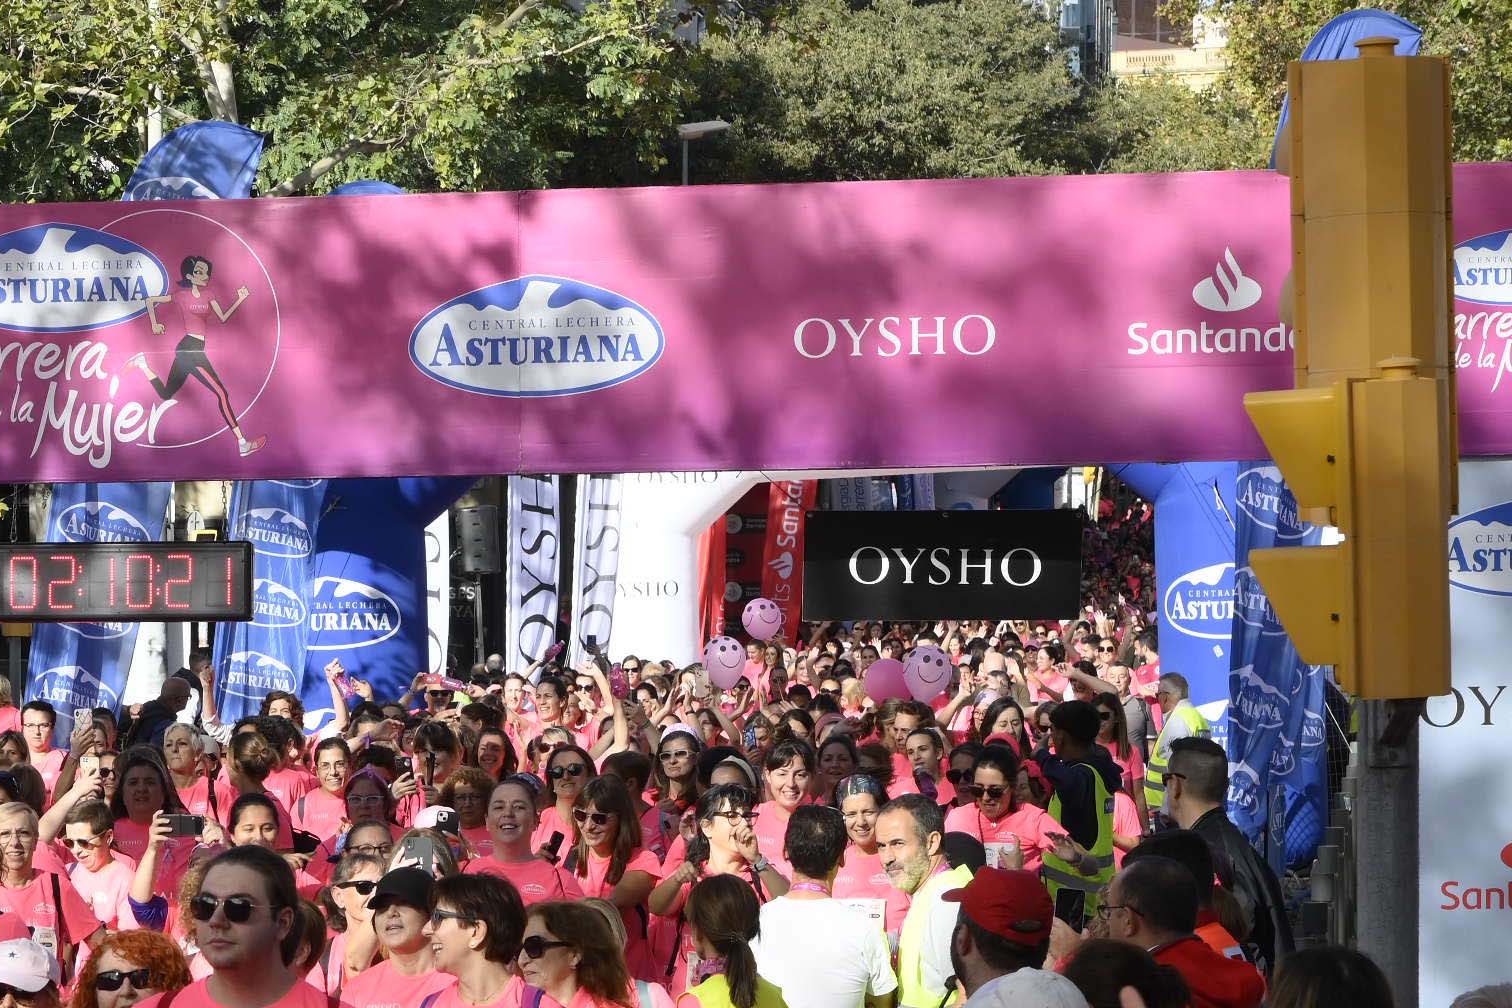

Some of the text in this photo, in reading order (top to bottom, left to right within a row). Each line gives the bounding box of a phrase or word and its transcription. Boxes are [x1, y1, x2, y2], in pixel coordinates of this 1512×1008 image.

[72, 259, 144, 272] LECHERA
[468, 316, 636, 331] CENTRAL LECHERA
[794, 314, 997, 358] OYSHO
[1127, 321, 1296, 355] Santand
[1454, 312, 1512, 340] arre
[429, 323, 644, 367] ASTURIANA
[1478, 341, 1496, 368] la
[10, 384, 34, 424] la
[29, 375, 179, 469] Mujer
[519, 474, 556, 667] OYSH
[578, 471, 620, 653] OYSH
[848, 546, 1042, 587] OYSHO
[10, 555, 233, 609] 02:10:21
[618, 580, 679, 597] YSHO
[311, 612, 392, 631] URIANA
[314, 601, 334, 610] RAL
[228, 672, 291, 692] STURIANA
[1420, 685, 1507, 728] OY
[1440, 880, 1512, 911] San
